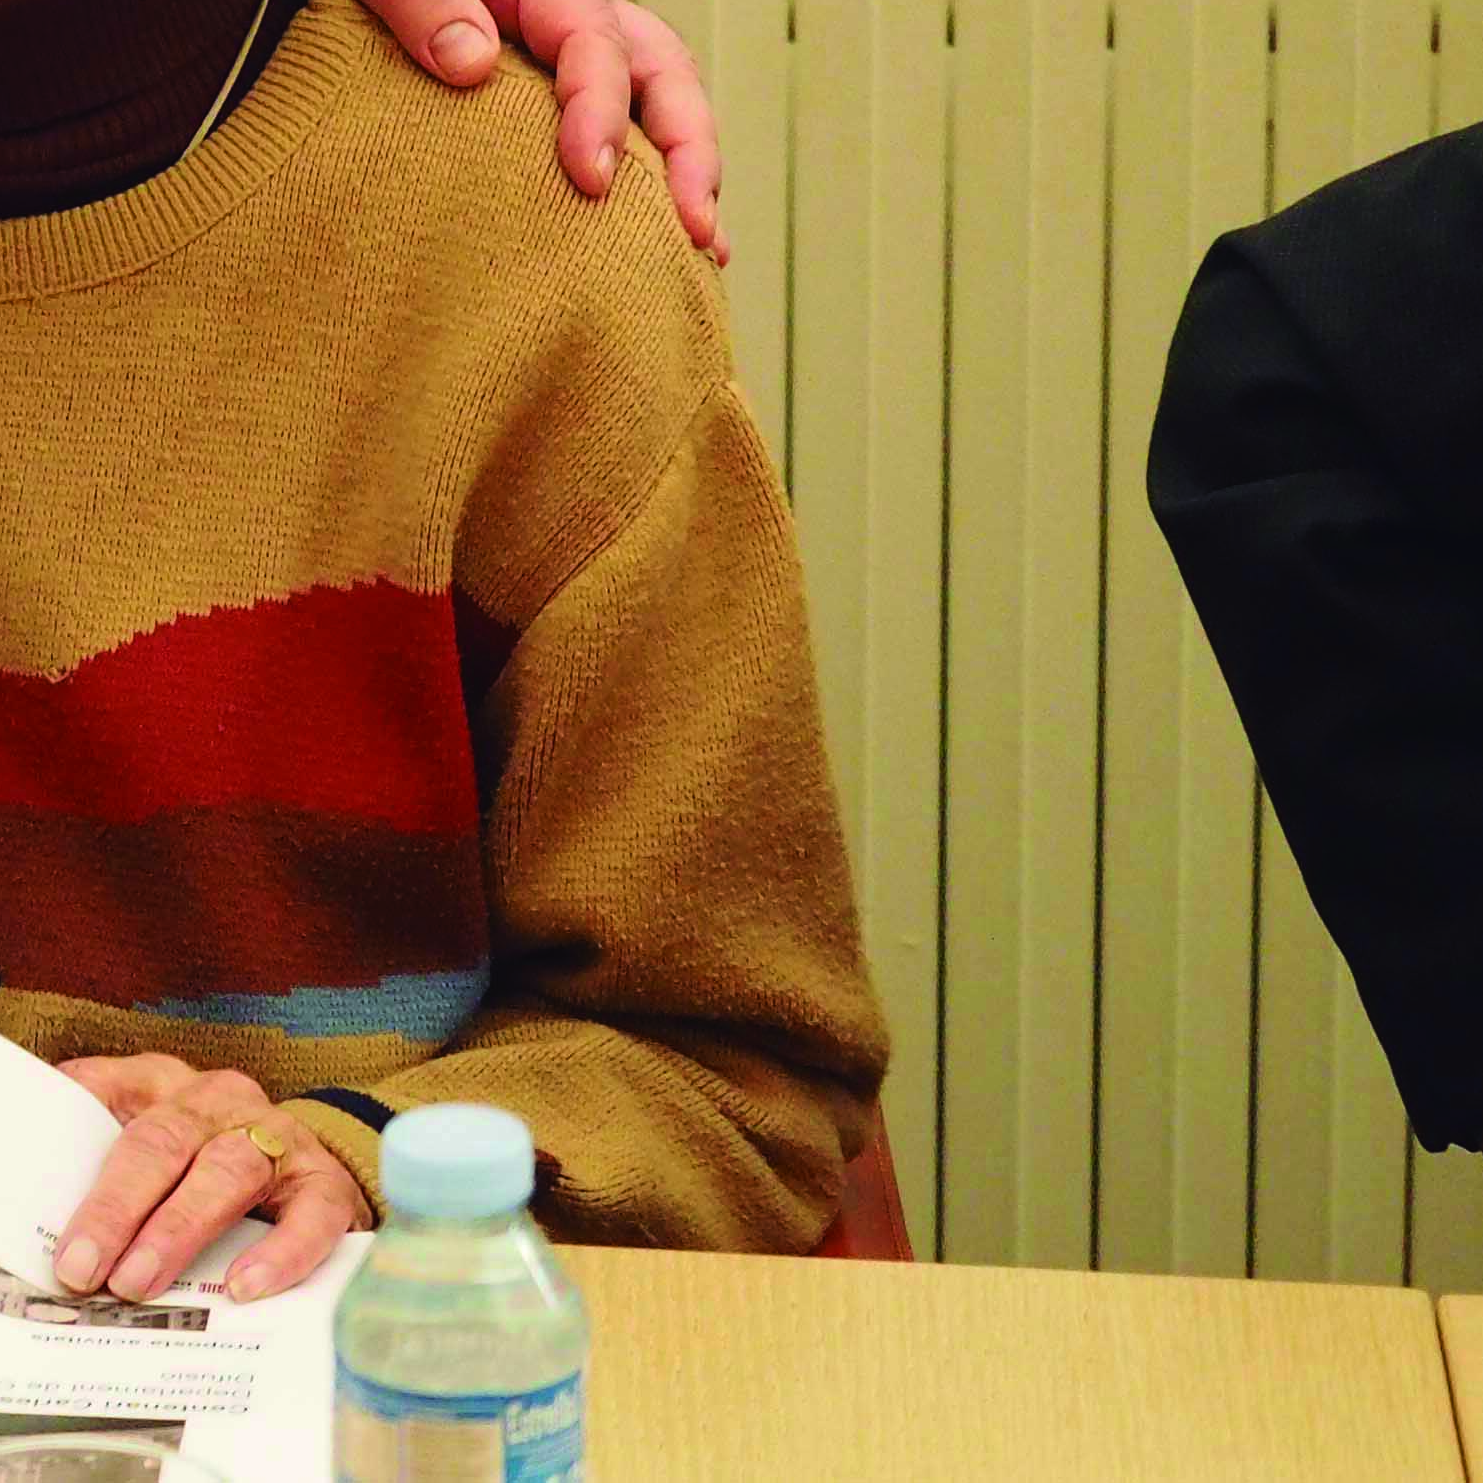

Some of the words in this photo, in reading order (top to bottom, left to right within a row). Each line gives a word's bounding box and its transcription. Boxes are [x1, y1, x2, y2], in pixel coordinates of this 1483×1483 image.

[31, 1334, 140, 1345] activitats
[150, 1340, 260, 1351] Proposta
[27, 1382, 61, 1391] de
[72, 1383, 251, 1397] Departament
[0, 1397, 92, 1409] Carles
[105, 1401, 248, 1413] Centenari
